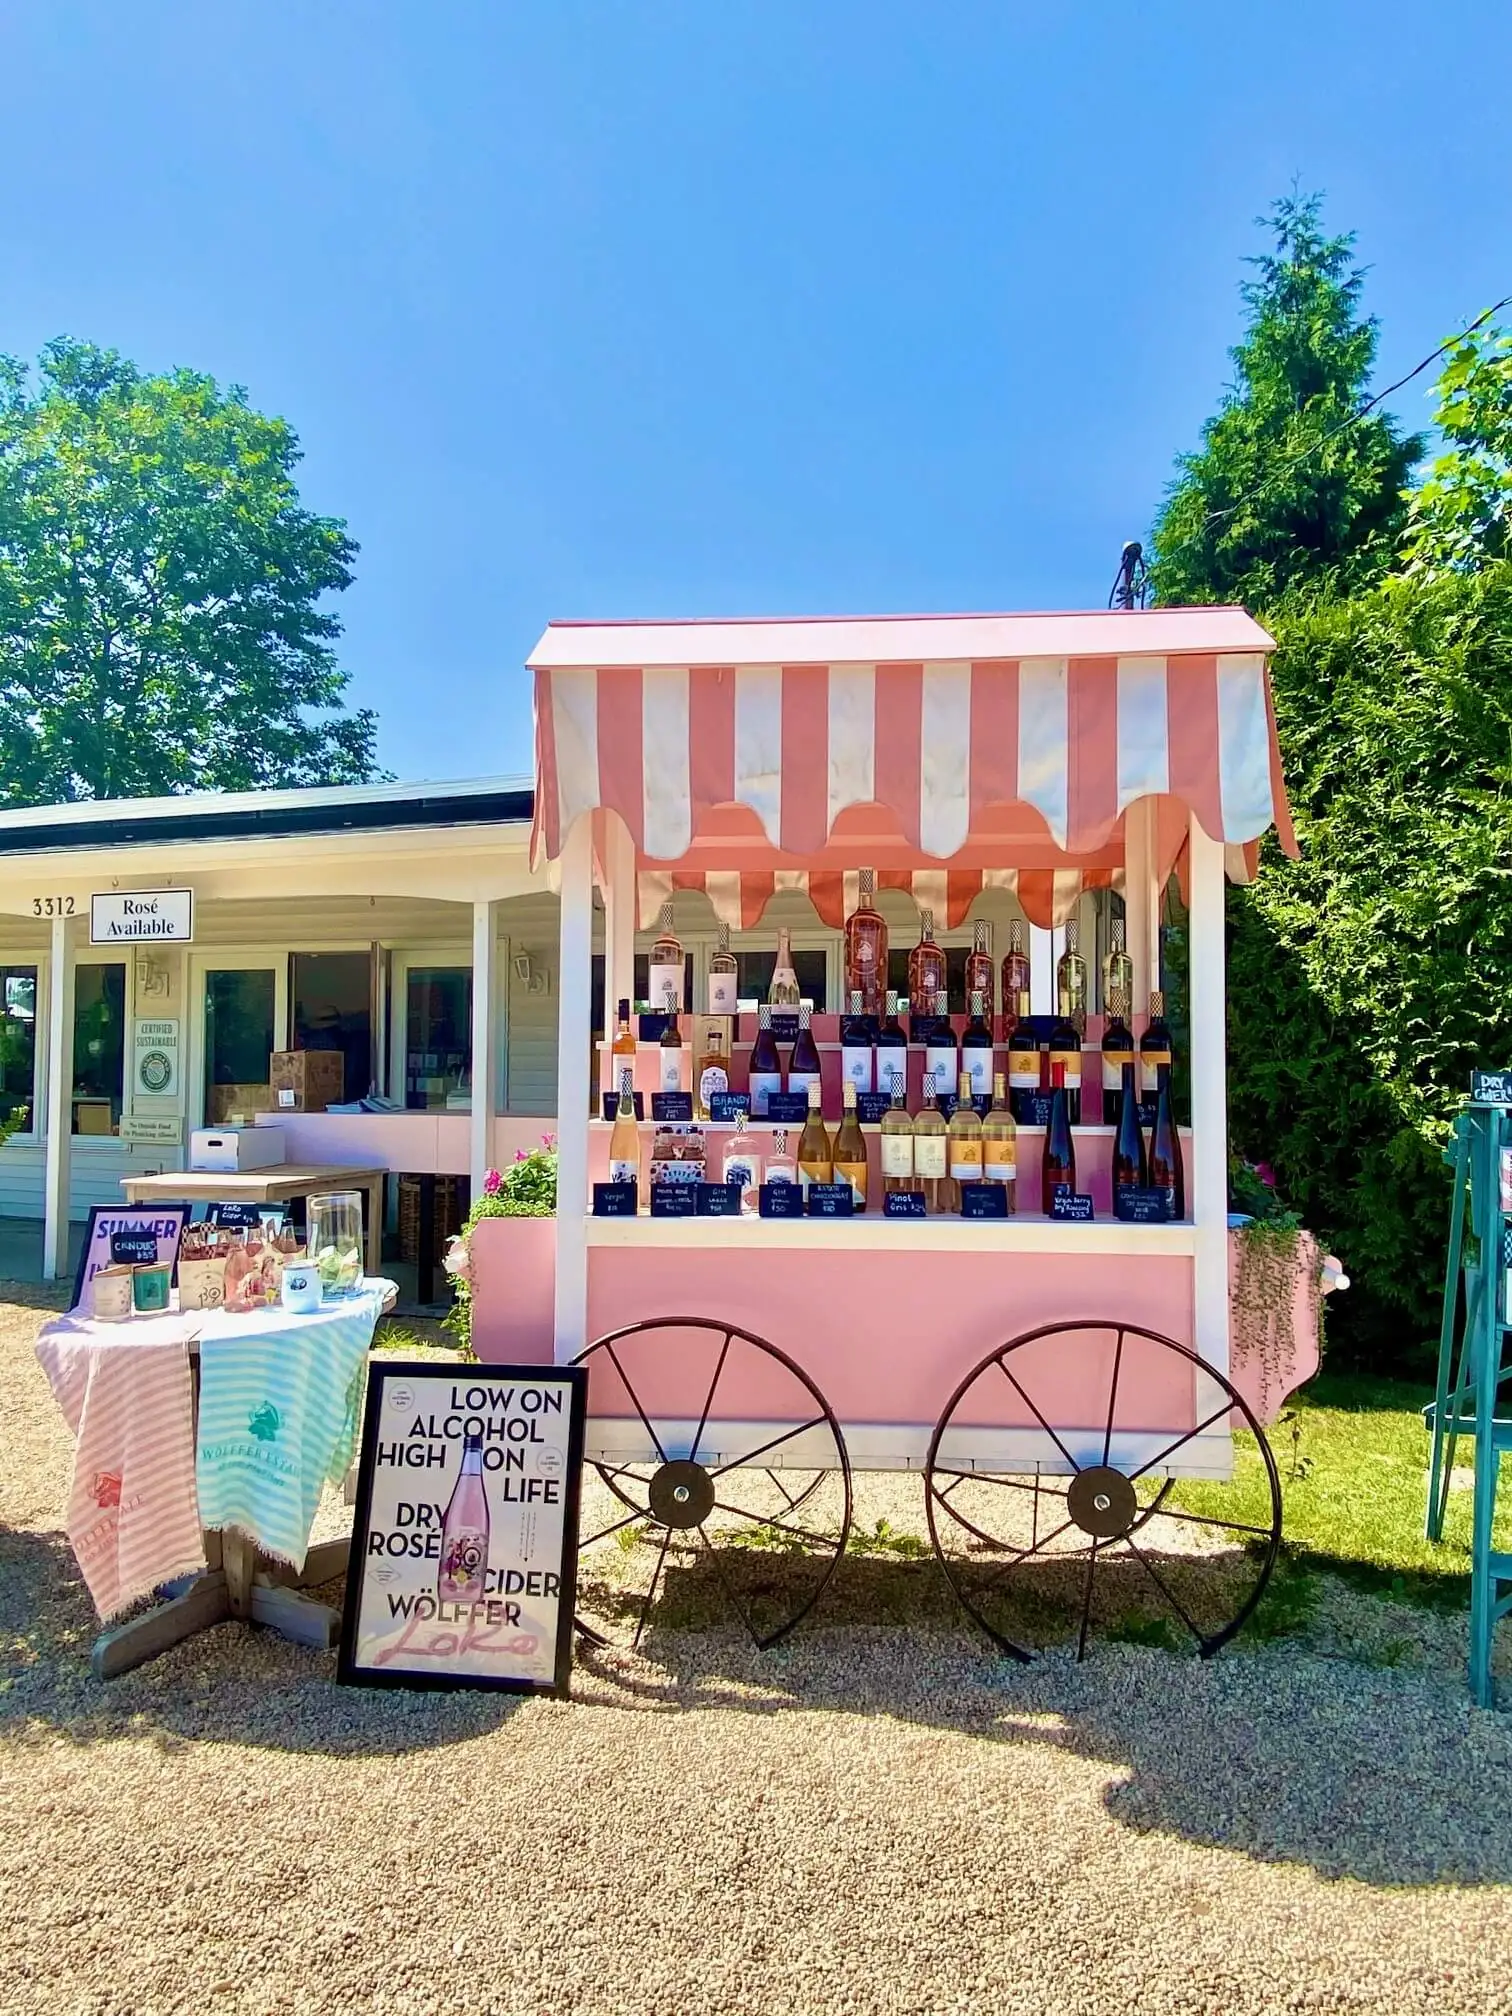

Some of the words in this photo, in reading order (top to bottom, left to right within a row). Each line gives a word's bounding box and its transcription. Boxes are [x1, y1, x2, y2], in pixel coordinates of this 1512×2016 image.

[32, 896, 75, 916] 3312
[123, 898, 158, 915] Rosé
[106, 919, 175, 936] Available
[141, 1023, 173, 1034] CERTIFIED
[136, 1036, 177, 1047] SUSTAINABLE
[1480, 1074, 1505, 1089] DRY
[97, 1220, 176, 1239] SUMMER
[451, 1386, 514, 1412] LOW
[520, 1389, 562, 1414] ON
[408, 1414, 545, 1443] ALCOHOL
[377, 1442, 446, 1469] HIGH
[483, 1446, 525, 1471] ON
[503, 1477, 560, 1504] LIFE
[368, 1528, 441, 1559] ROSÉ
[483, 1569, 560, 1598] CIDER
